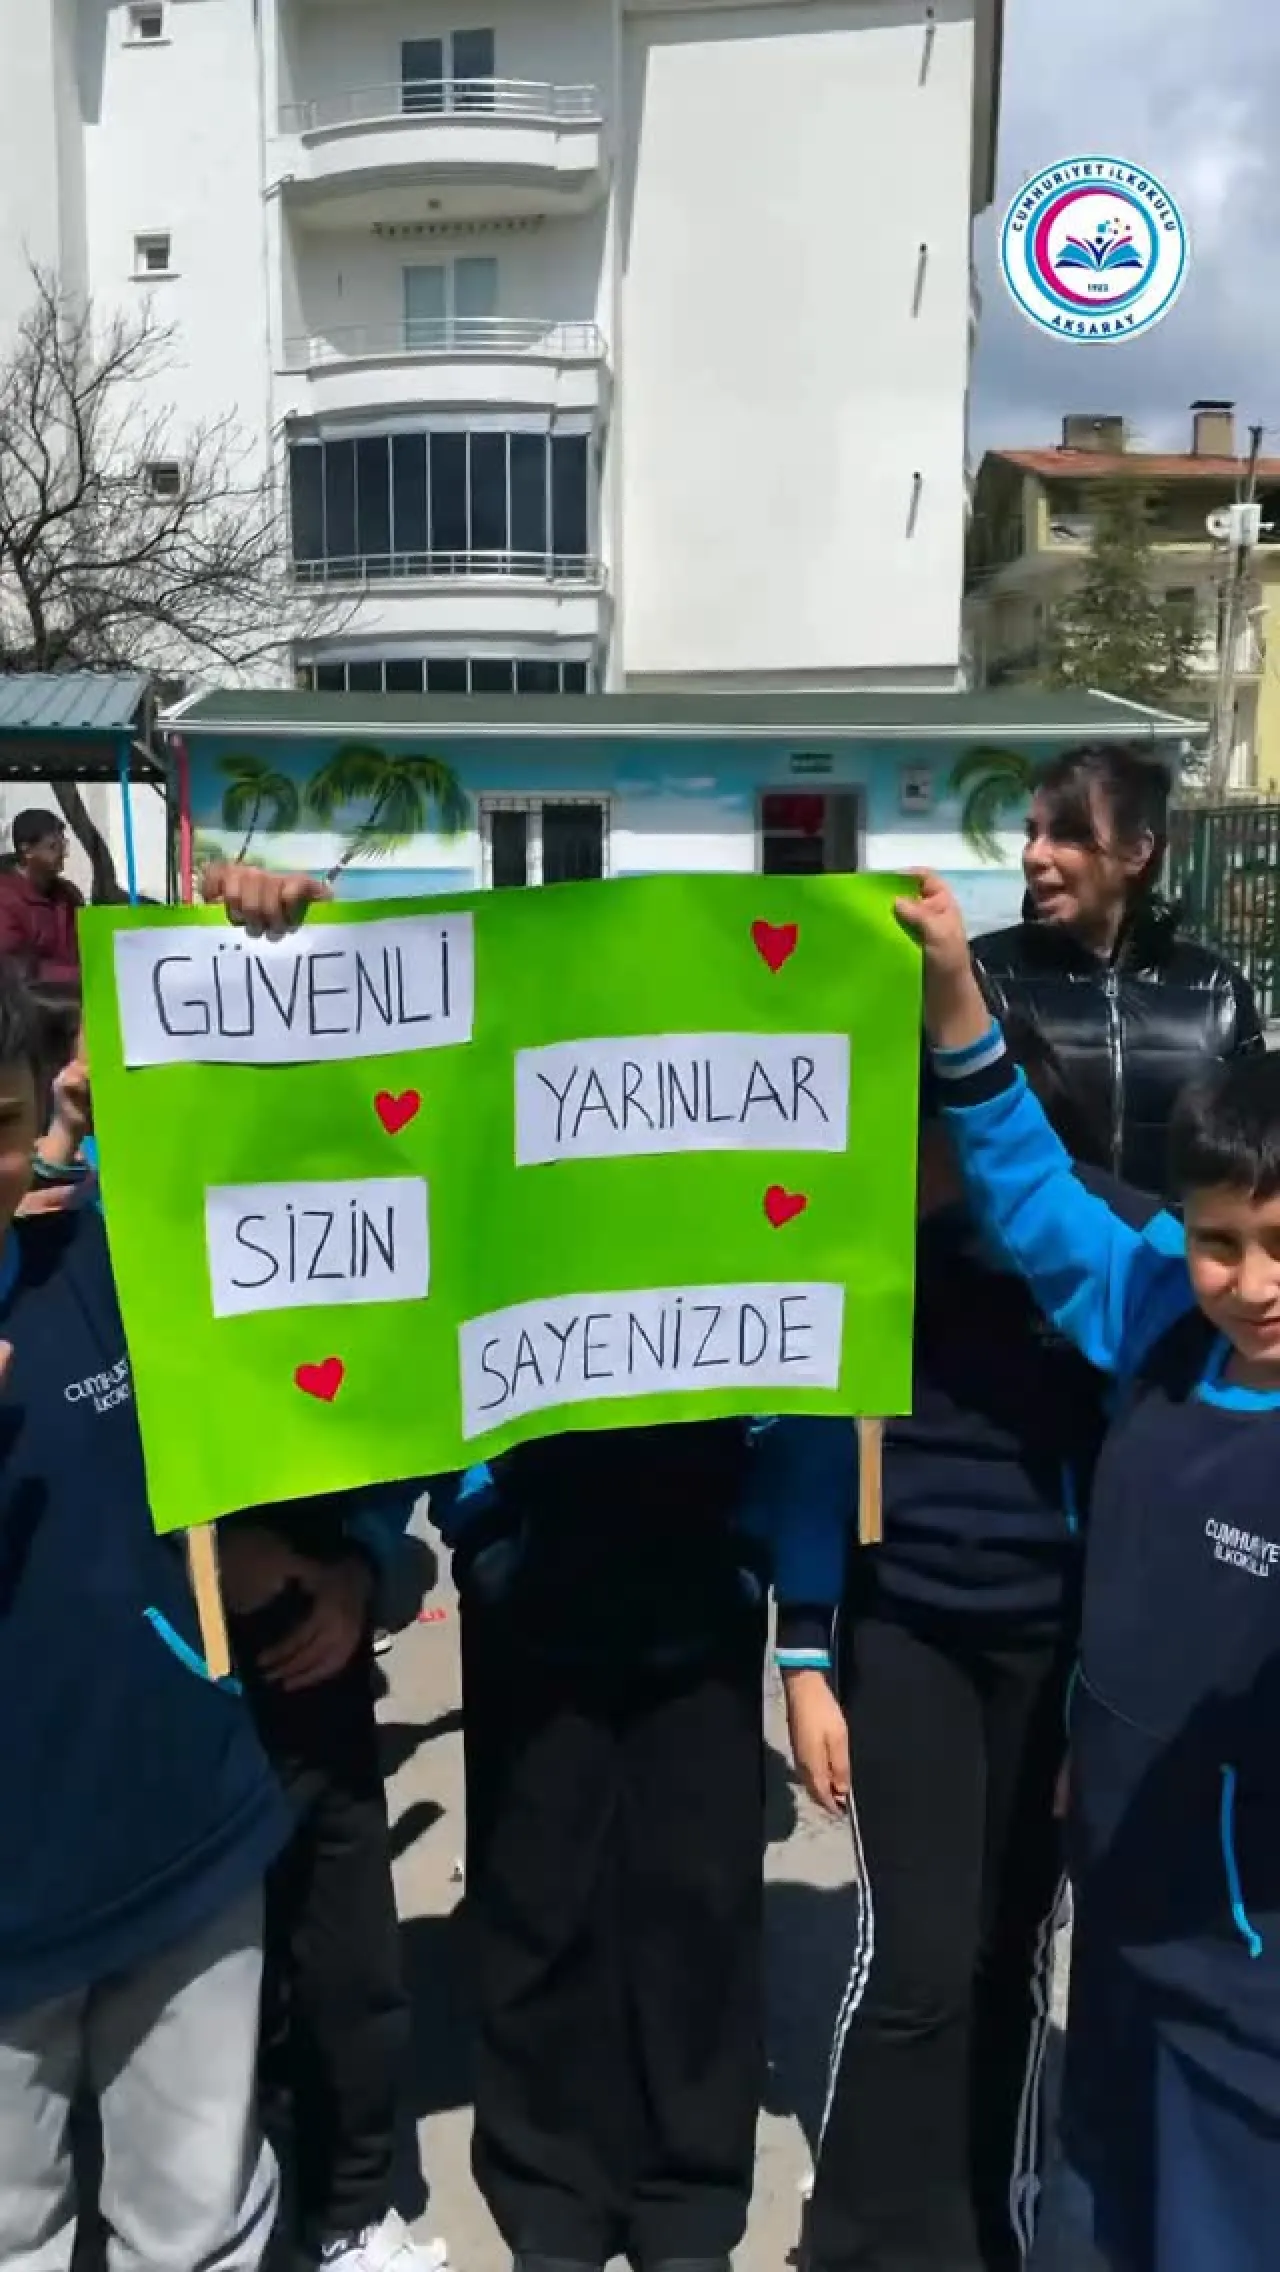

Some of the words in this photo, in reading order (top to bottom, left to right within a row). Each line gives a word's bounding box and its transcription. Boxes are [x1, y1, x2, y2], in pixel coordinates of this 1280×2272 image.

[151, 930, 451, 1037] GÜVENLİ
[536, 1055, 830, 1143] YARINLAR
[230, 1199, 395, 1289] SİZİN
[477, 1296, 812, 1411] SAYENİZDE
